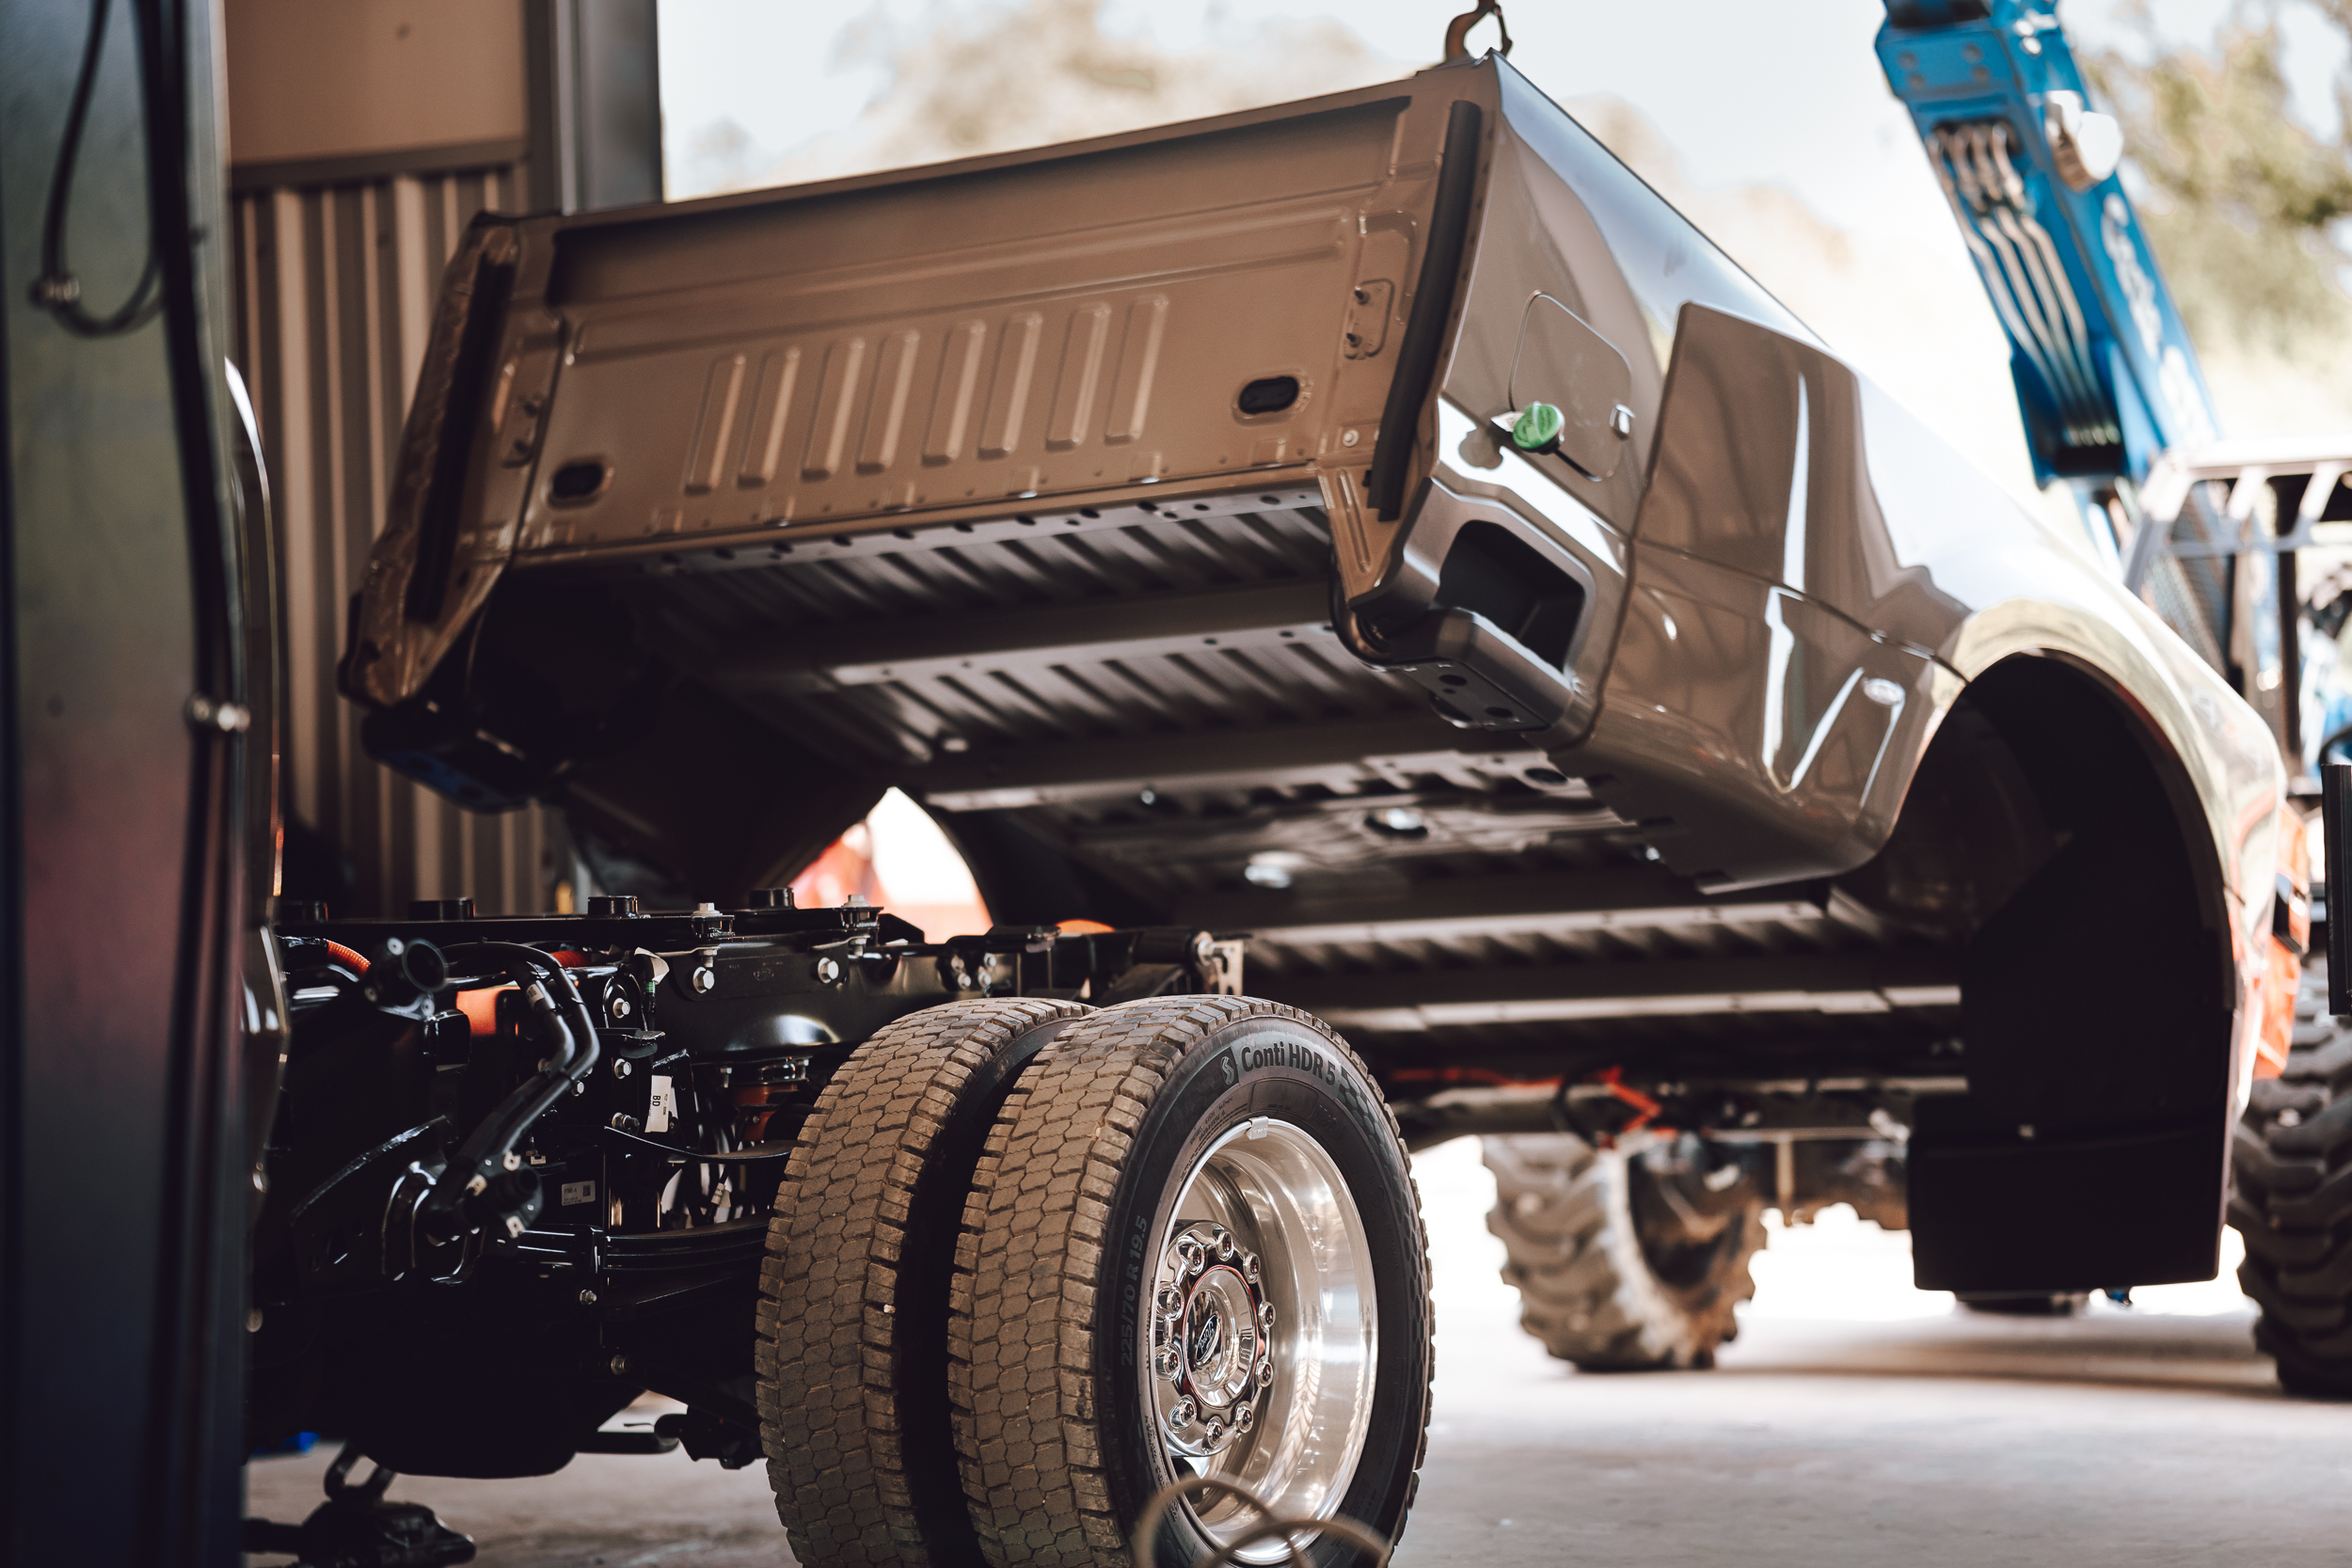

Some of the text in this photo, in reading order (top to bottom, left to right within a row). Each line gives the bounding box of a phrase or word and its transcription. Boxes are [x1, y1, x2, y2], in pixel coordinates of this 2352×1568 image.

[1241, 1041, 1336, 1085] Conti HDR 5
[652, 1095, 661, 1107] BD
[1120, 1214, 1148, 1367] 225/70 R 19.5
[1199, 1320, 1216, 1354] Ford
